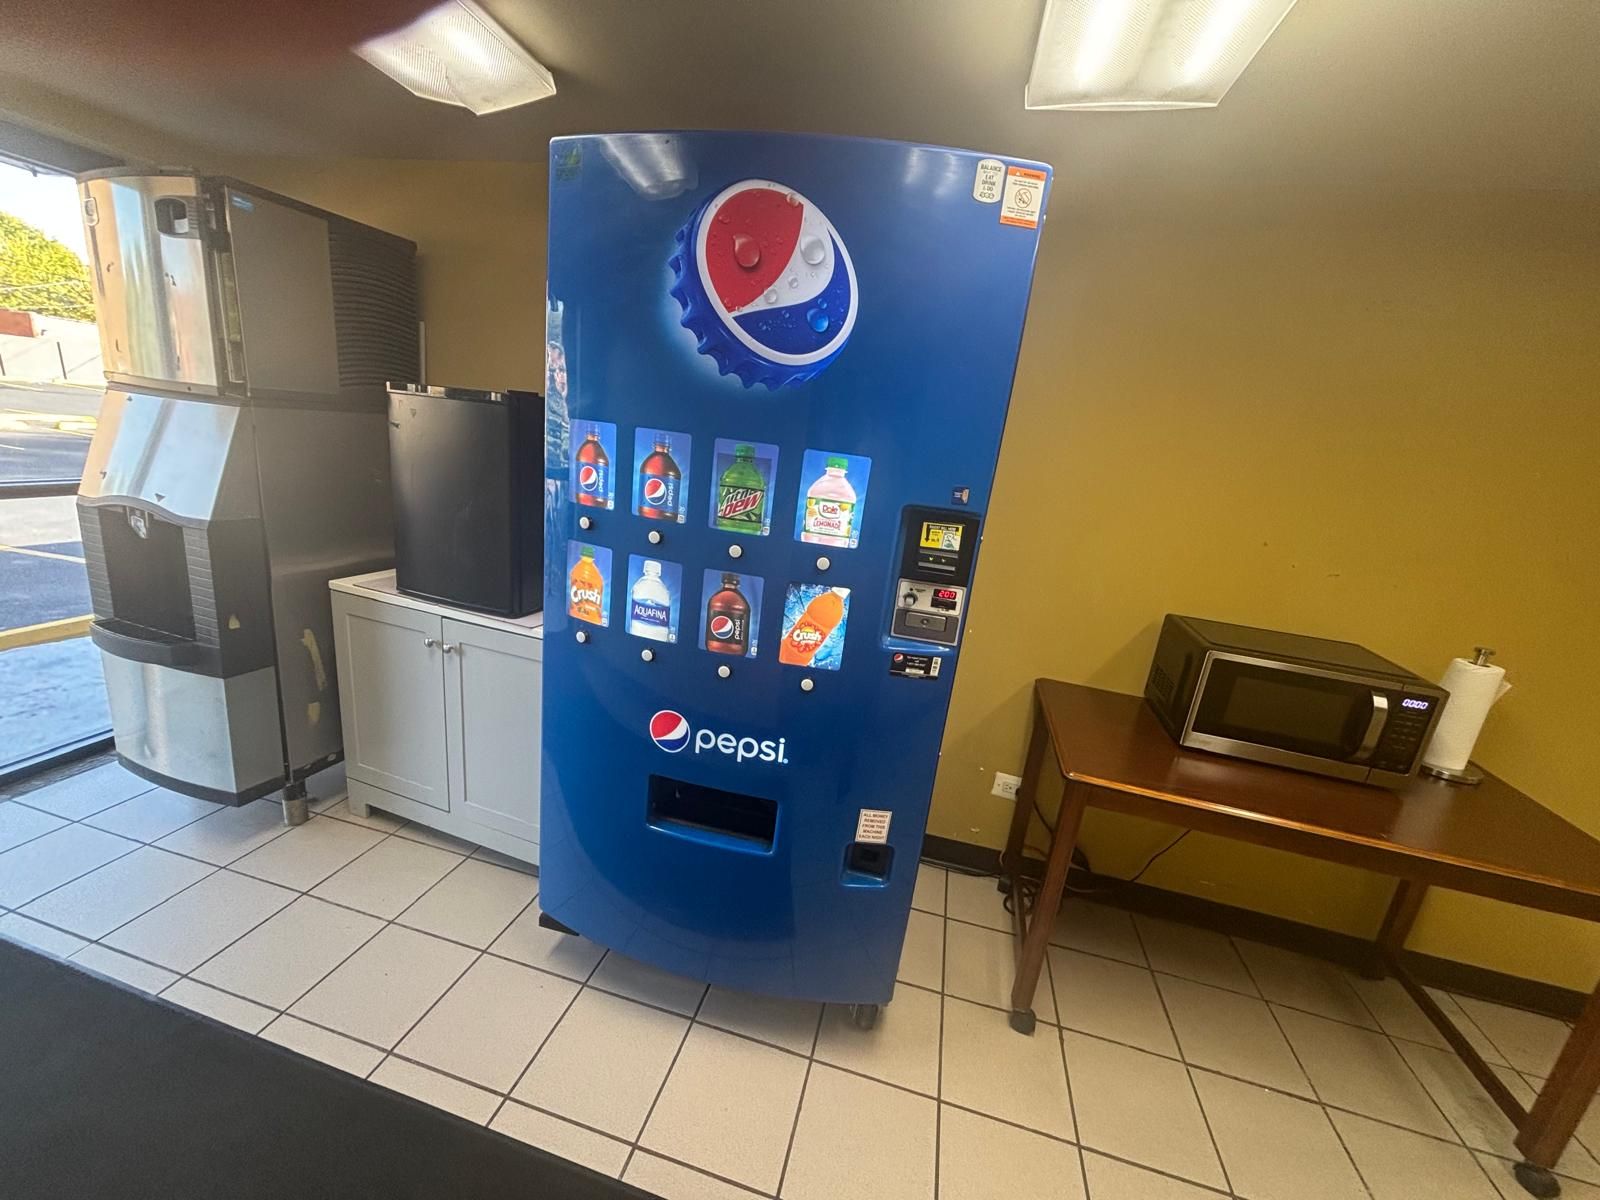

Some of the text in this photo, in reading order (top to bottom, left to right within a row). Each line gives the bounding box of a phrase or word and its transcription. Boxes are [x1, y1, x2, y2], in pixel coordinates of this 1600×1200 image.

[571, 585, 601, 605] Crush
[634, 605, 667, 621] AQUAFINA
[793, 629, 822, 642] Crush
